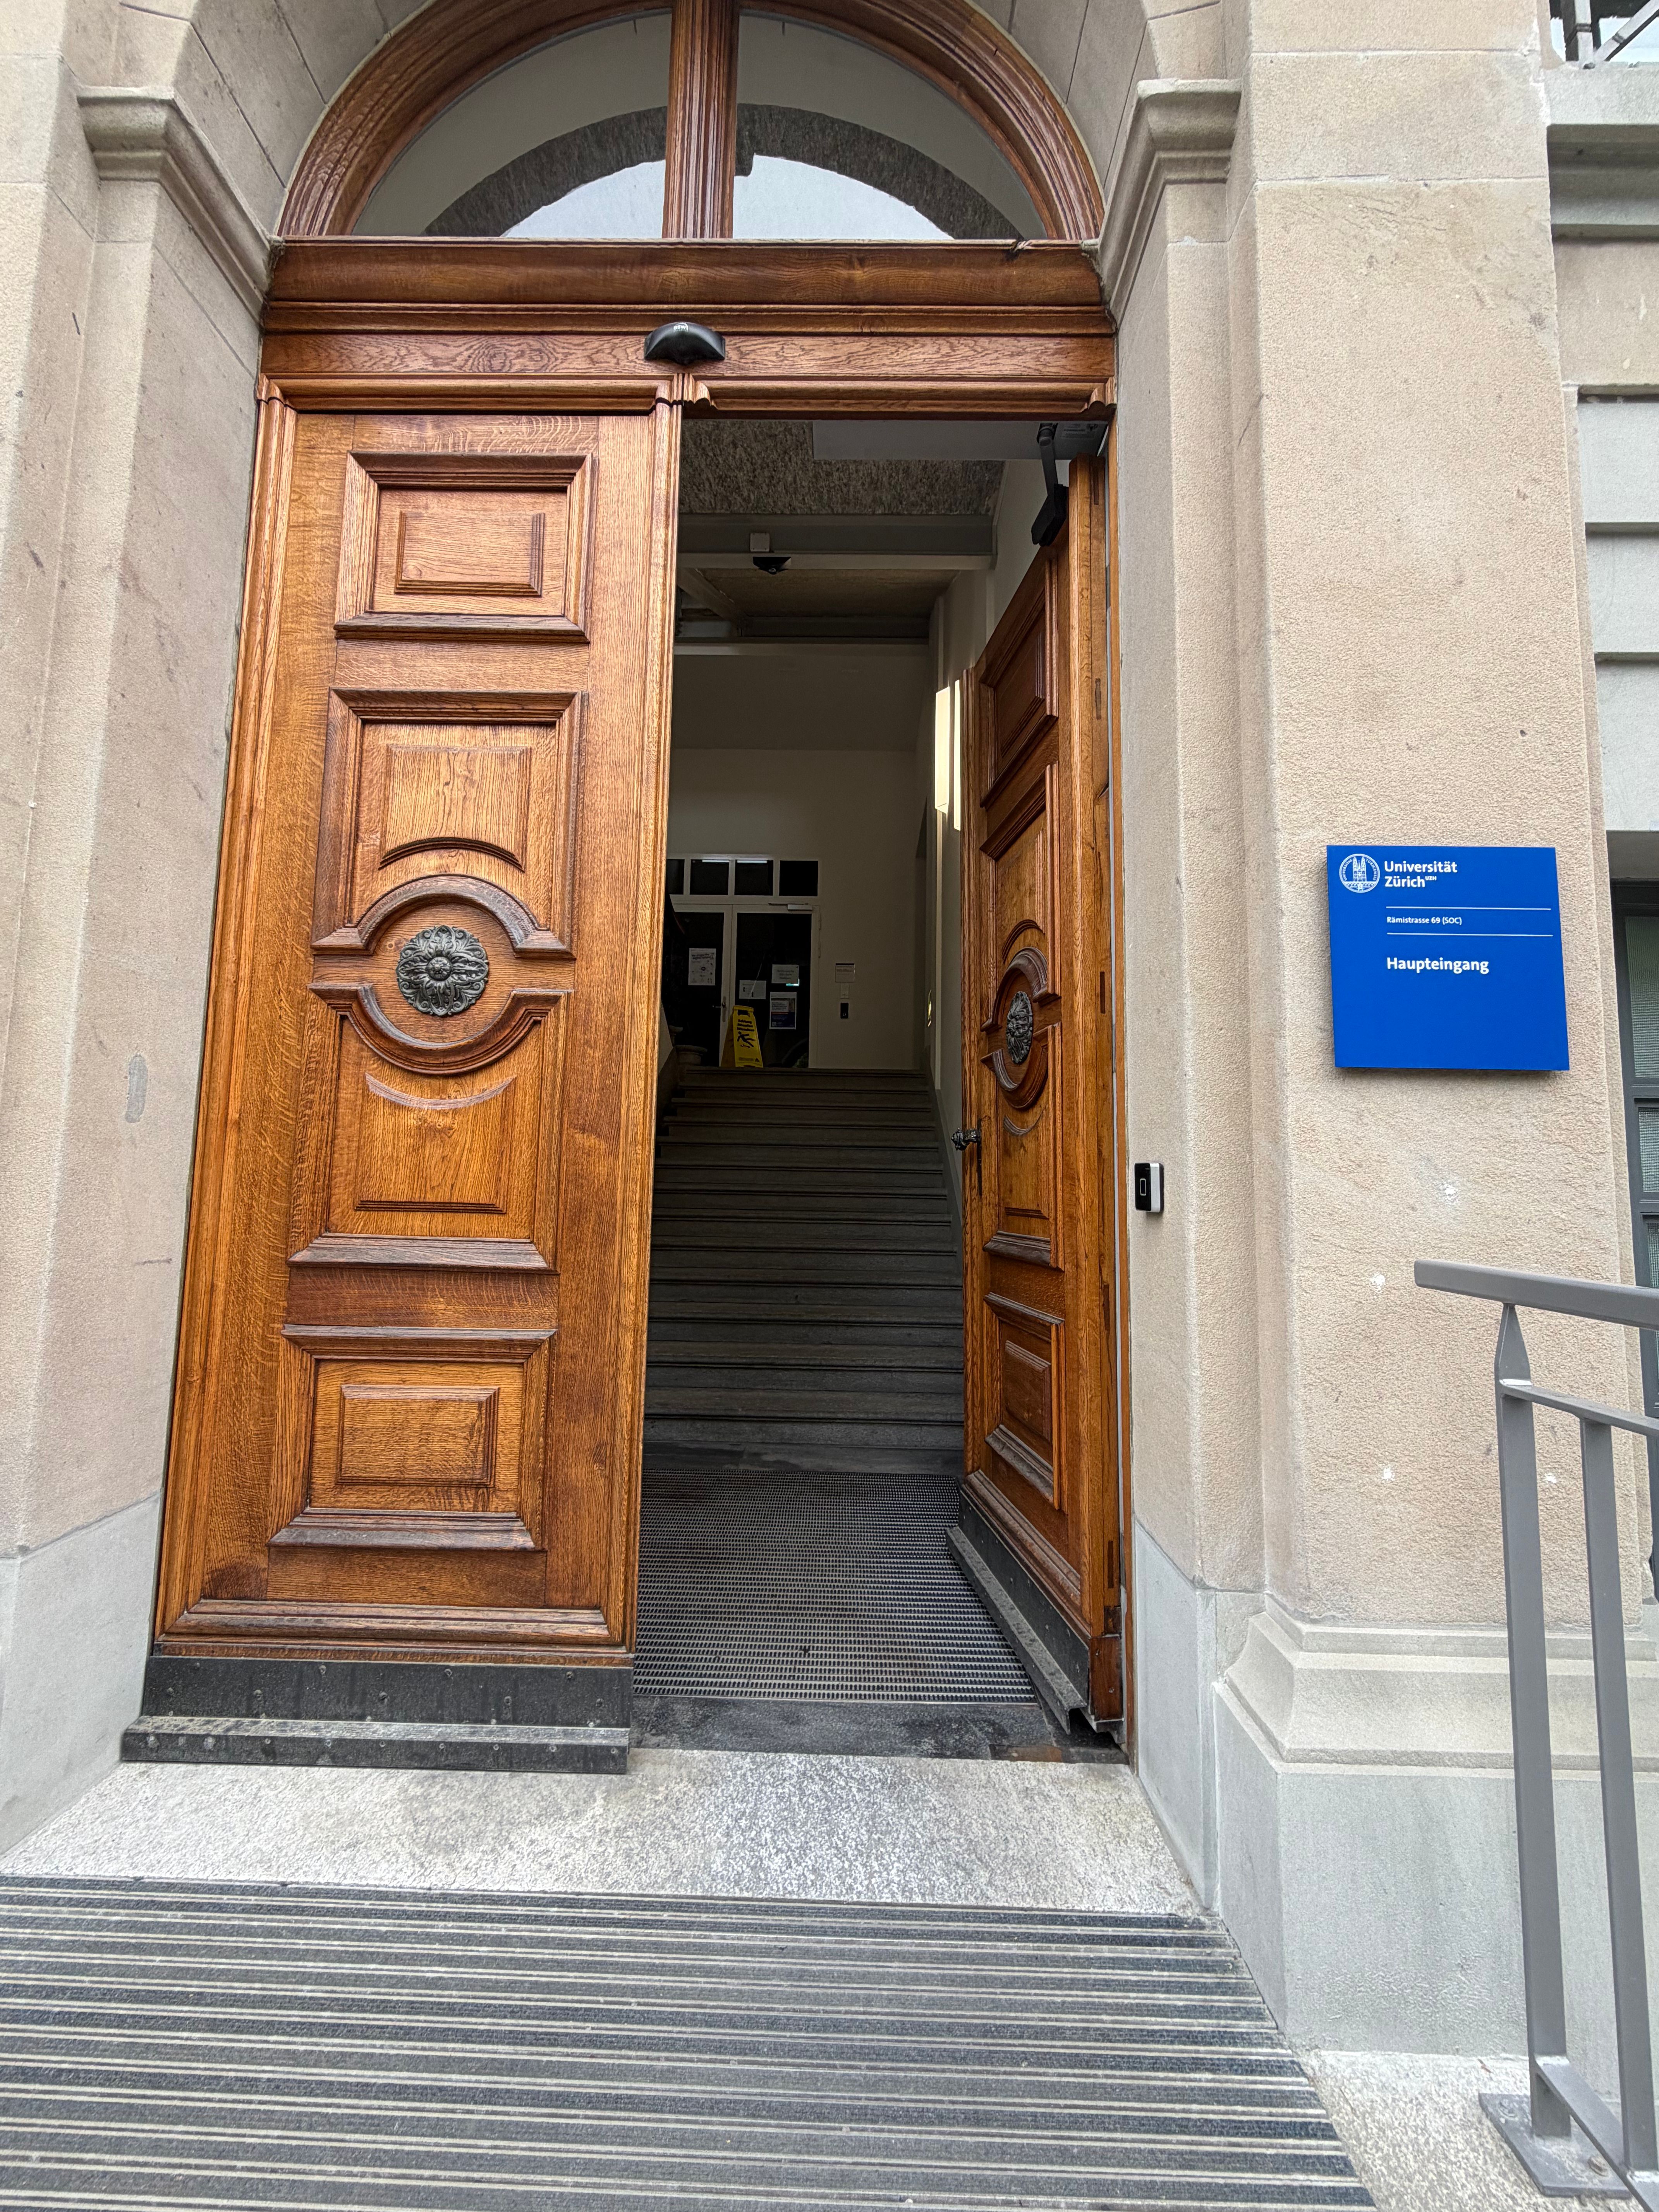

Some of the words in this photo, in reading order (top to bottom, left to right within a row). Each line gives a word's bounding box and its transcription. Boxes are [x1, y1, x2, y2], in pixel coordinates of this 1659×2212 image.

[1384, 860, 1458, 872] Universität
[1384, 876, 1425, 887] Zürich
[1442, 916, 1462, 925] (SOC)
[1387, 957, 1489, 974] Haupteingang
